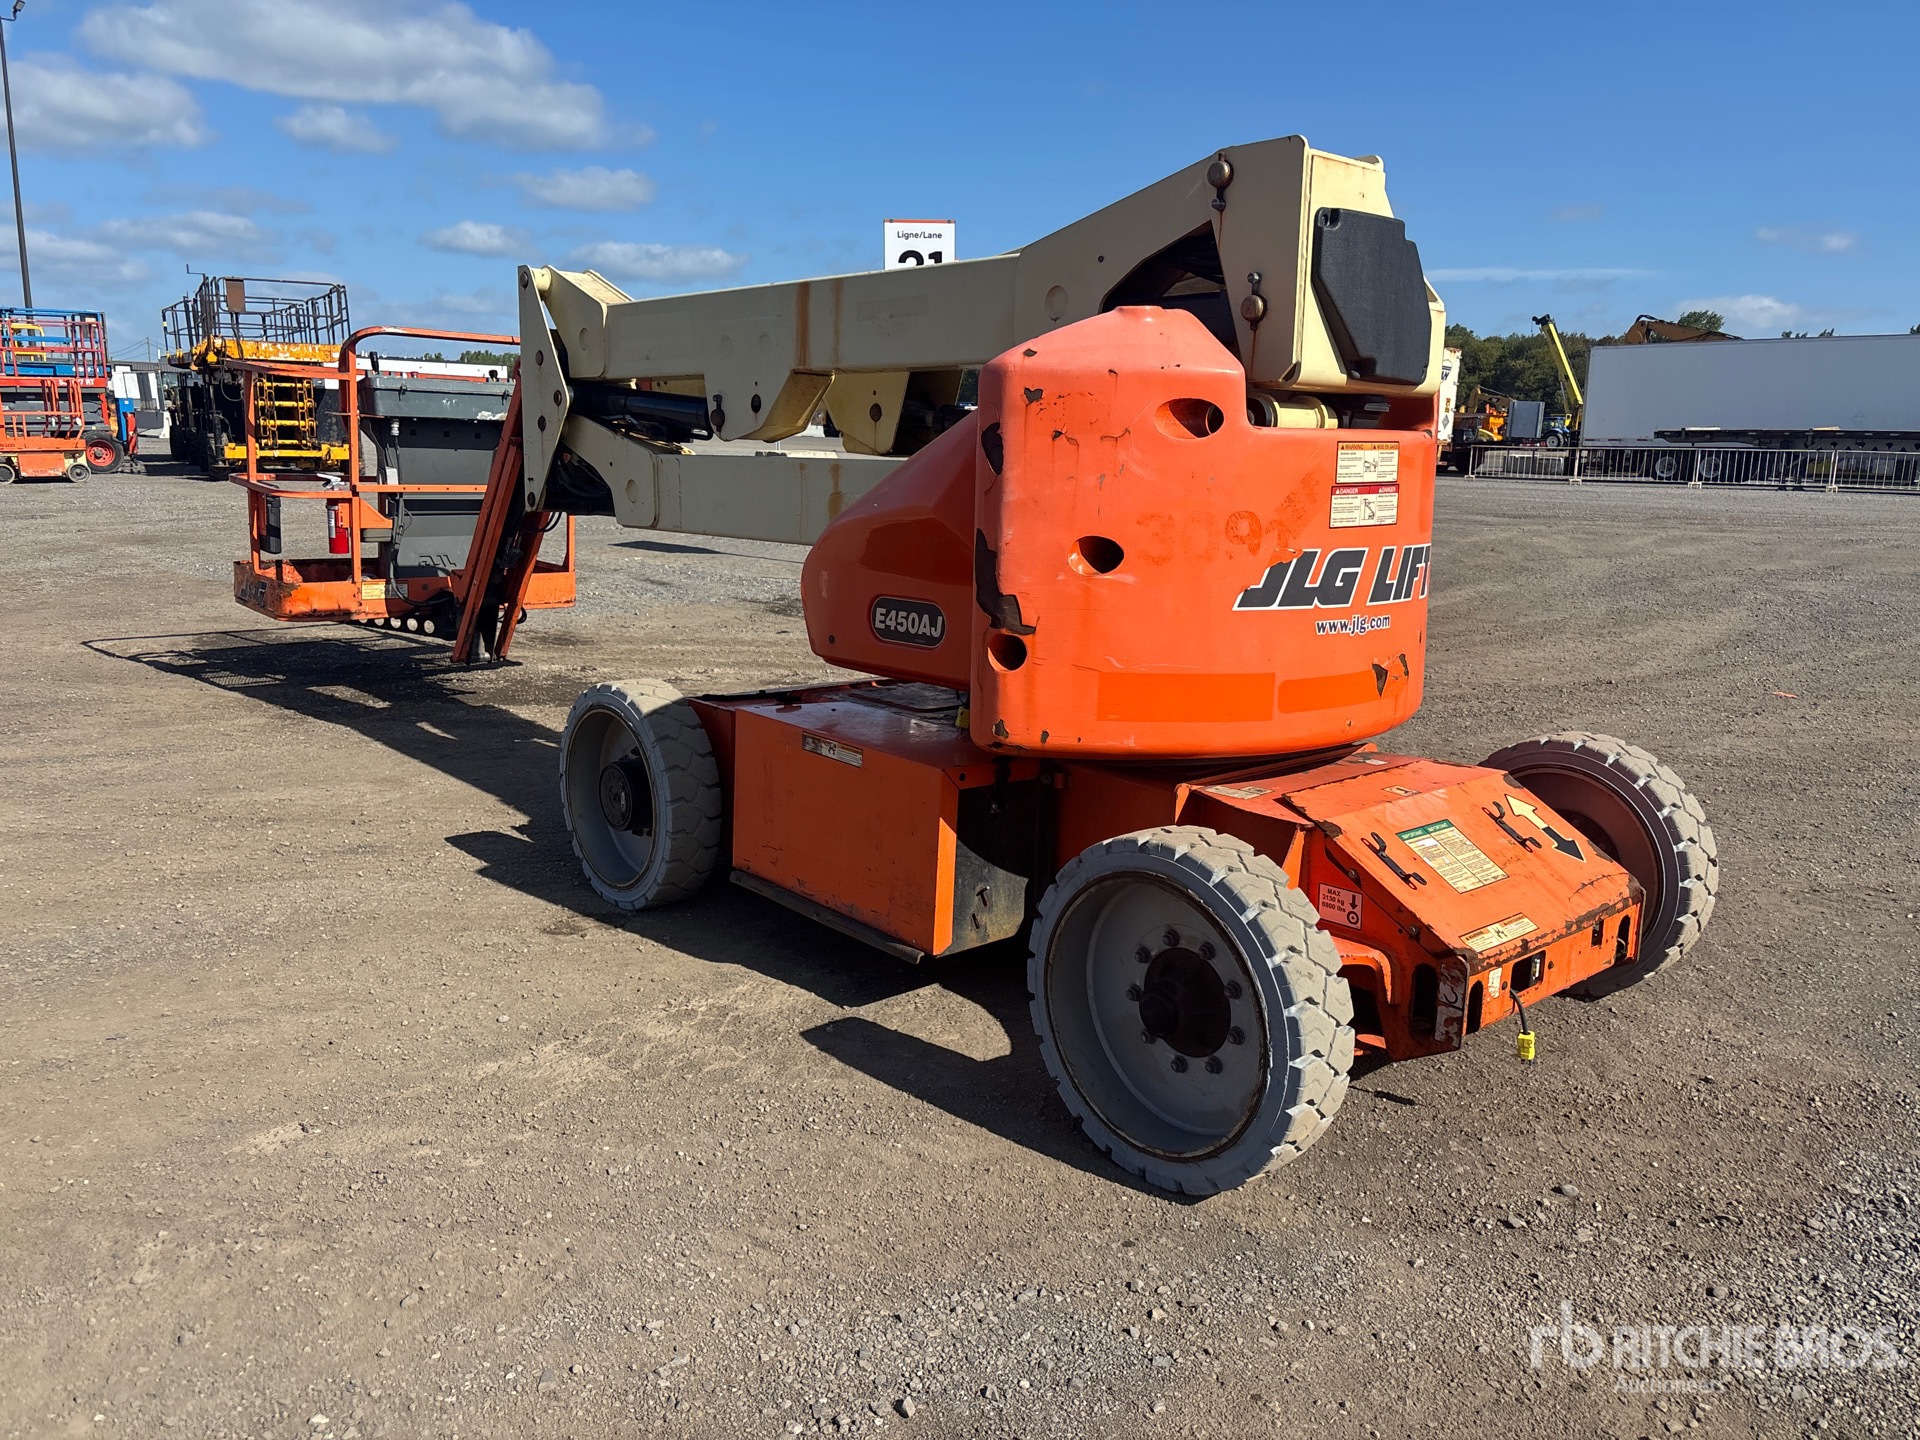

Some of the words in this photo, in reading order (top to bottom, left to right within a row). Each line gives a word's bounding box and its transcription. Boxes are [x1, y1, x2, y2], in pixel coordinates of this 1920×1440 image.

[897, 231, 943, 240] Ligne/Lane
[1232, 547, 1369, 611] JLG
[874, 607, 943, 638] E450AJ
[1315, 614, 1391, 636] www.jlg.com
[1327, 888, 1341, 897] MAX
[1321, 901, 1336, 910] 6900
[1336, 904, 1346, 913] lbs
[1322, 894, 1336, 902] 3130
[1337, 898, 1345, 907] kg
